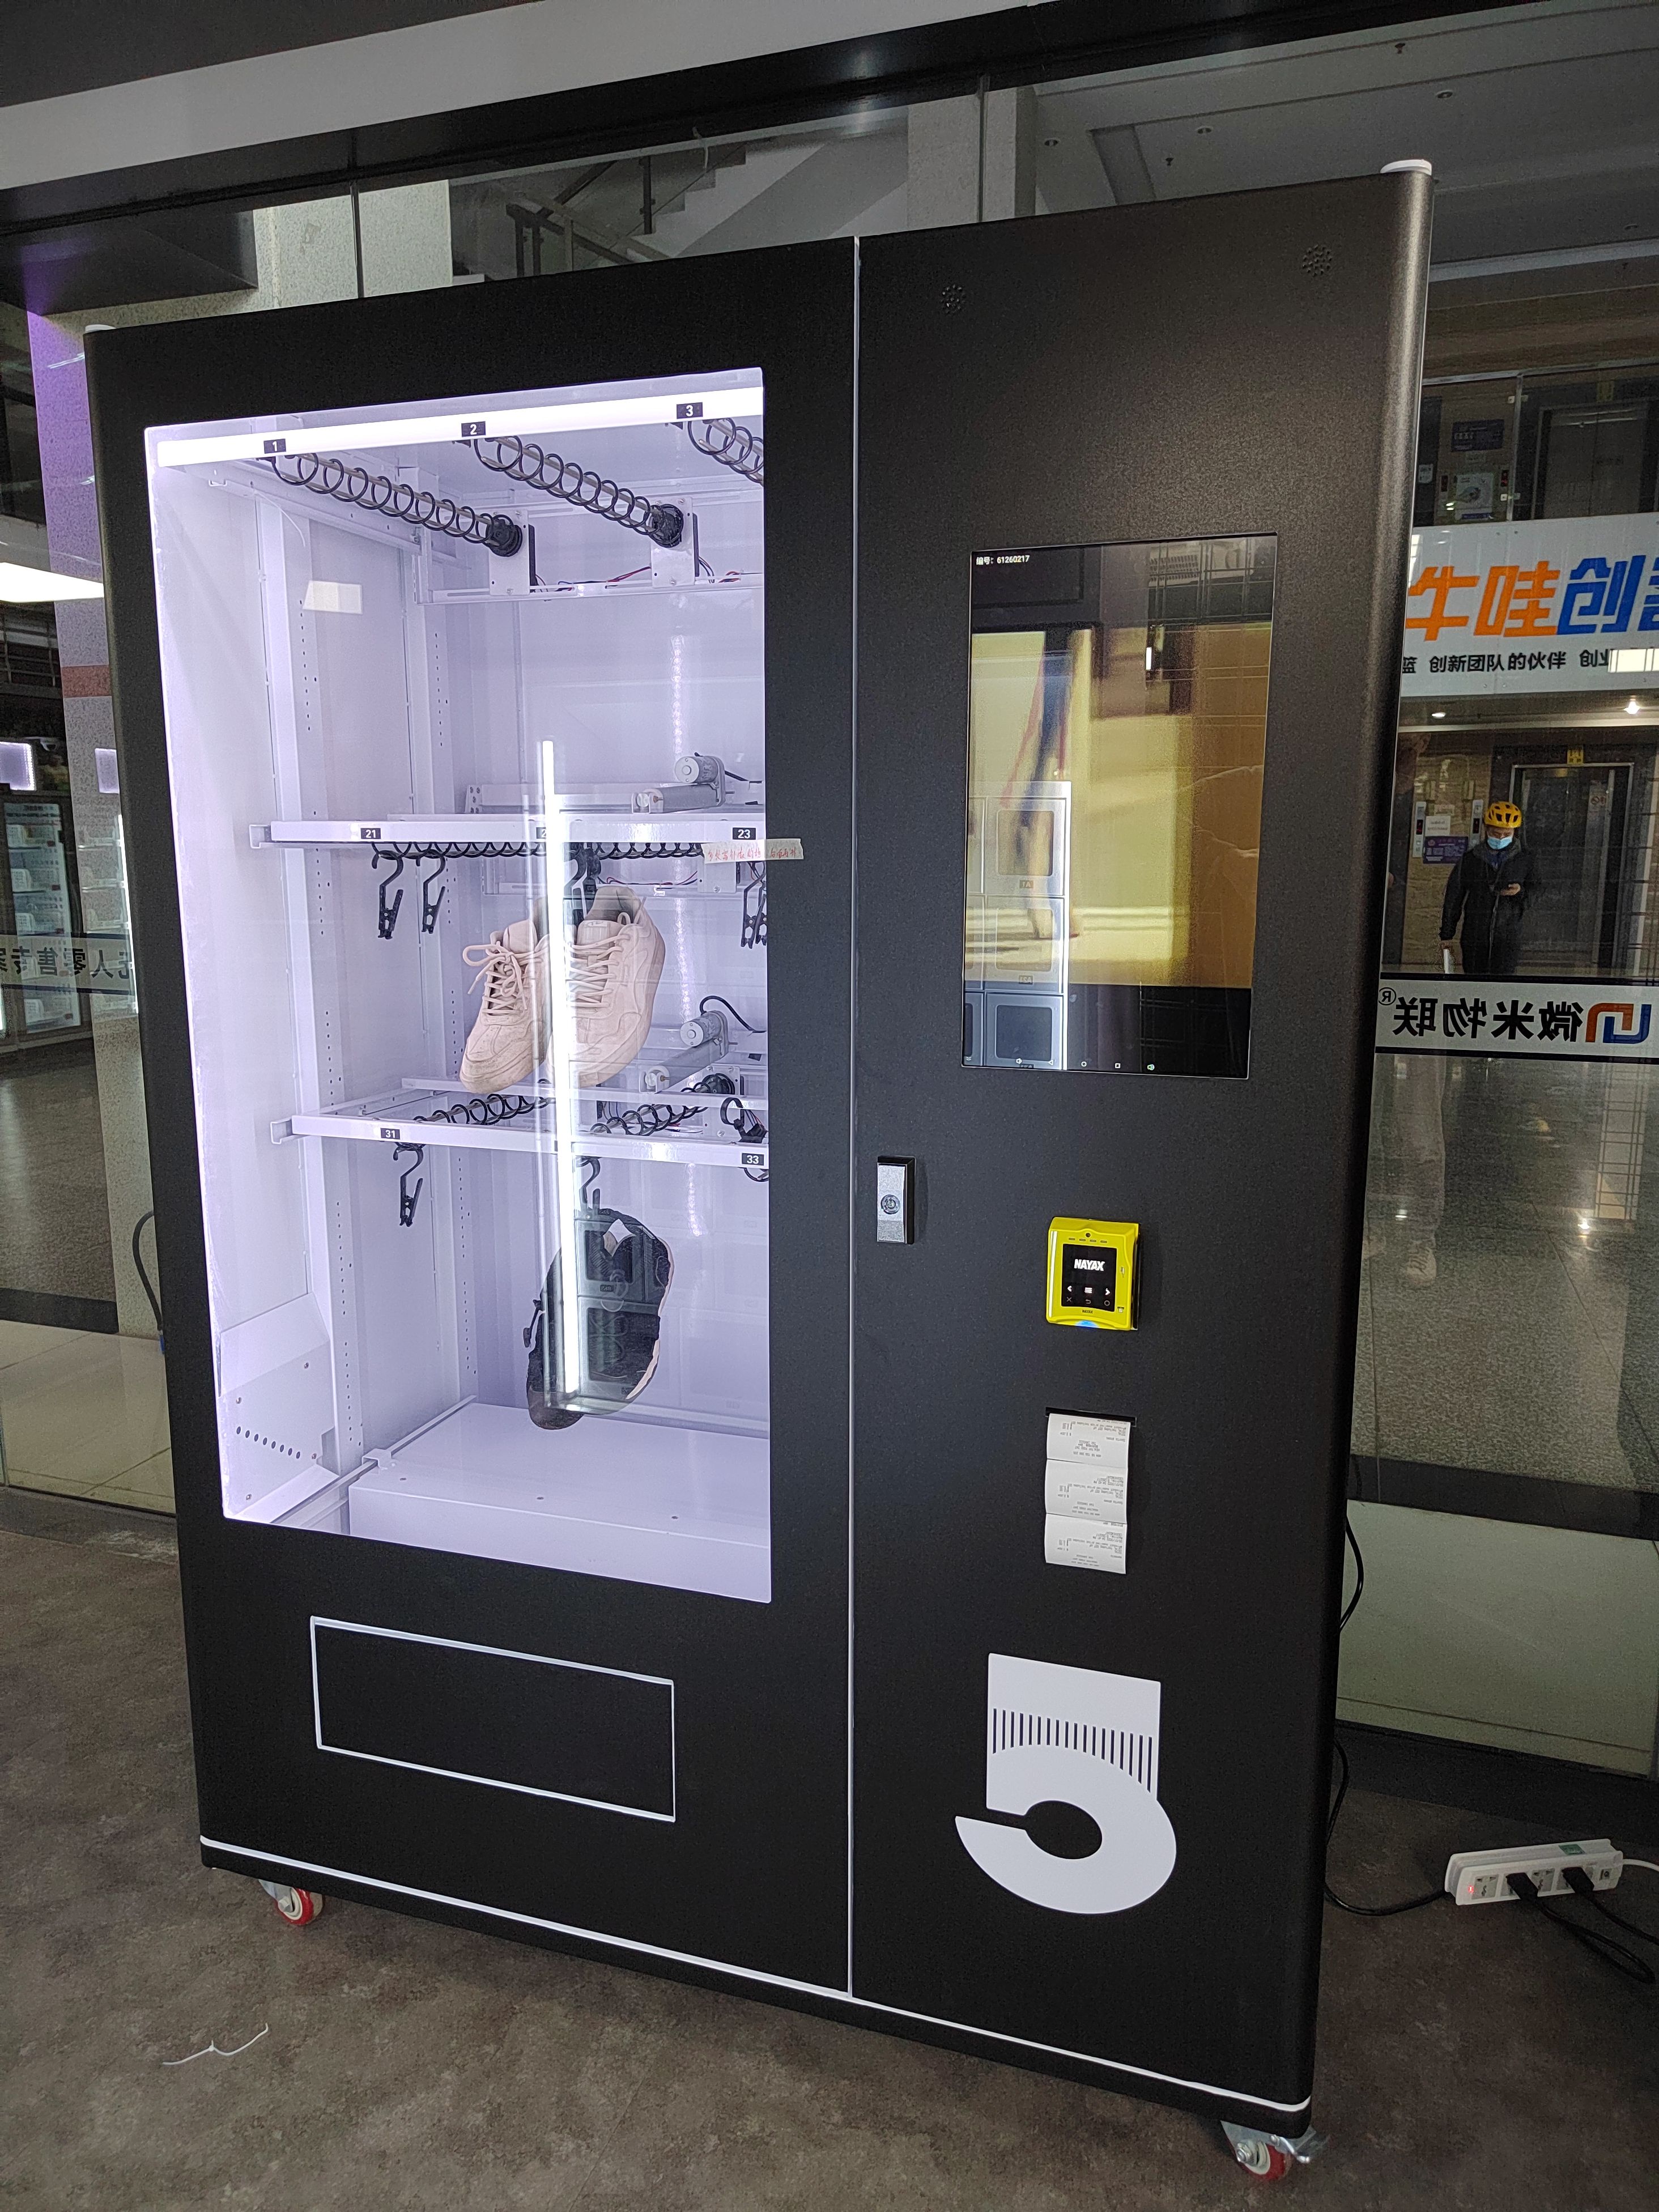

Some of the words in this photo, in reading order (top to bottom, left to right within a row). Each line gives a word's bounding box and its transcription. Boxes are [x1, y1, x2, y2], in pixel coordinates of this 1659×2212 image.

[686, 405, 694, 417] 3
[470, 424, 477, 435] 2
[272, 441, 278, 452] 1
[997, 555, 1030, 564] 61260217
[1430, 650, 1567, 674] 创新团队的伙伴
[365, 829, 376, 839] 21
[738, 829, 751, 839] 23
[385, 1129, 395, 1138] 31
[746, 1155, 759, 1164] 33
[1074, 1258, 1105, 1271] NAYAX
